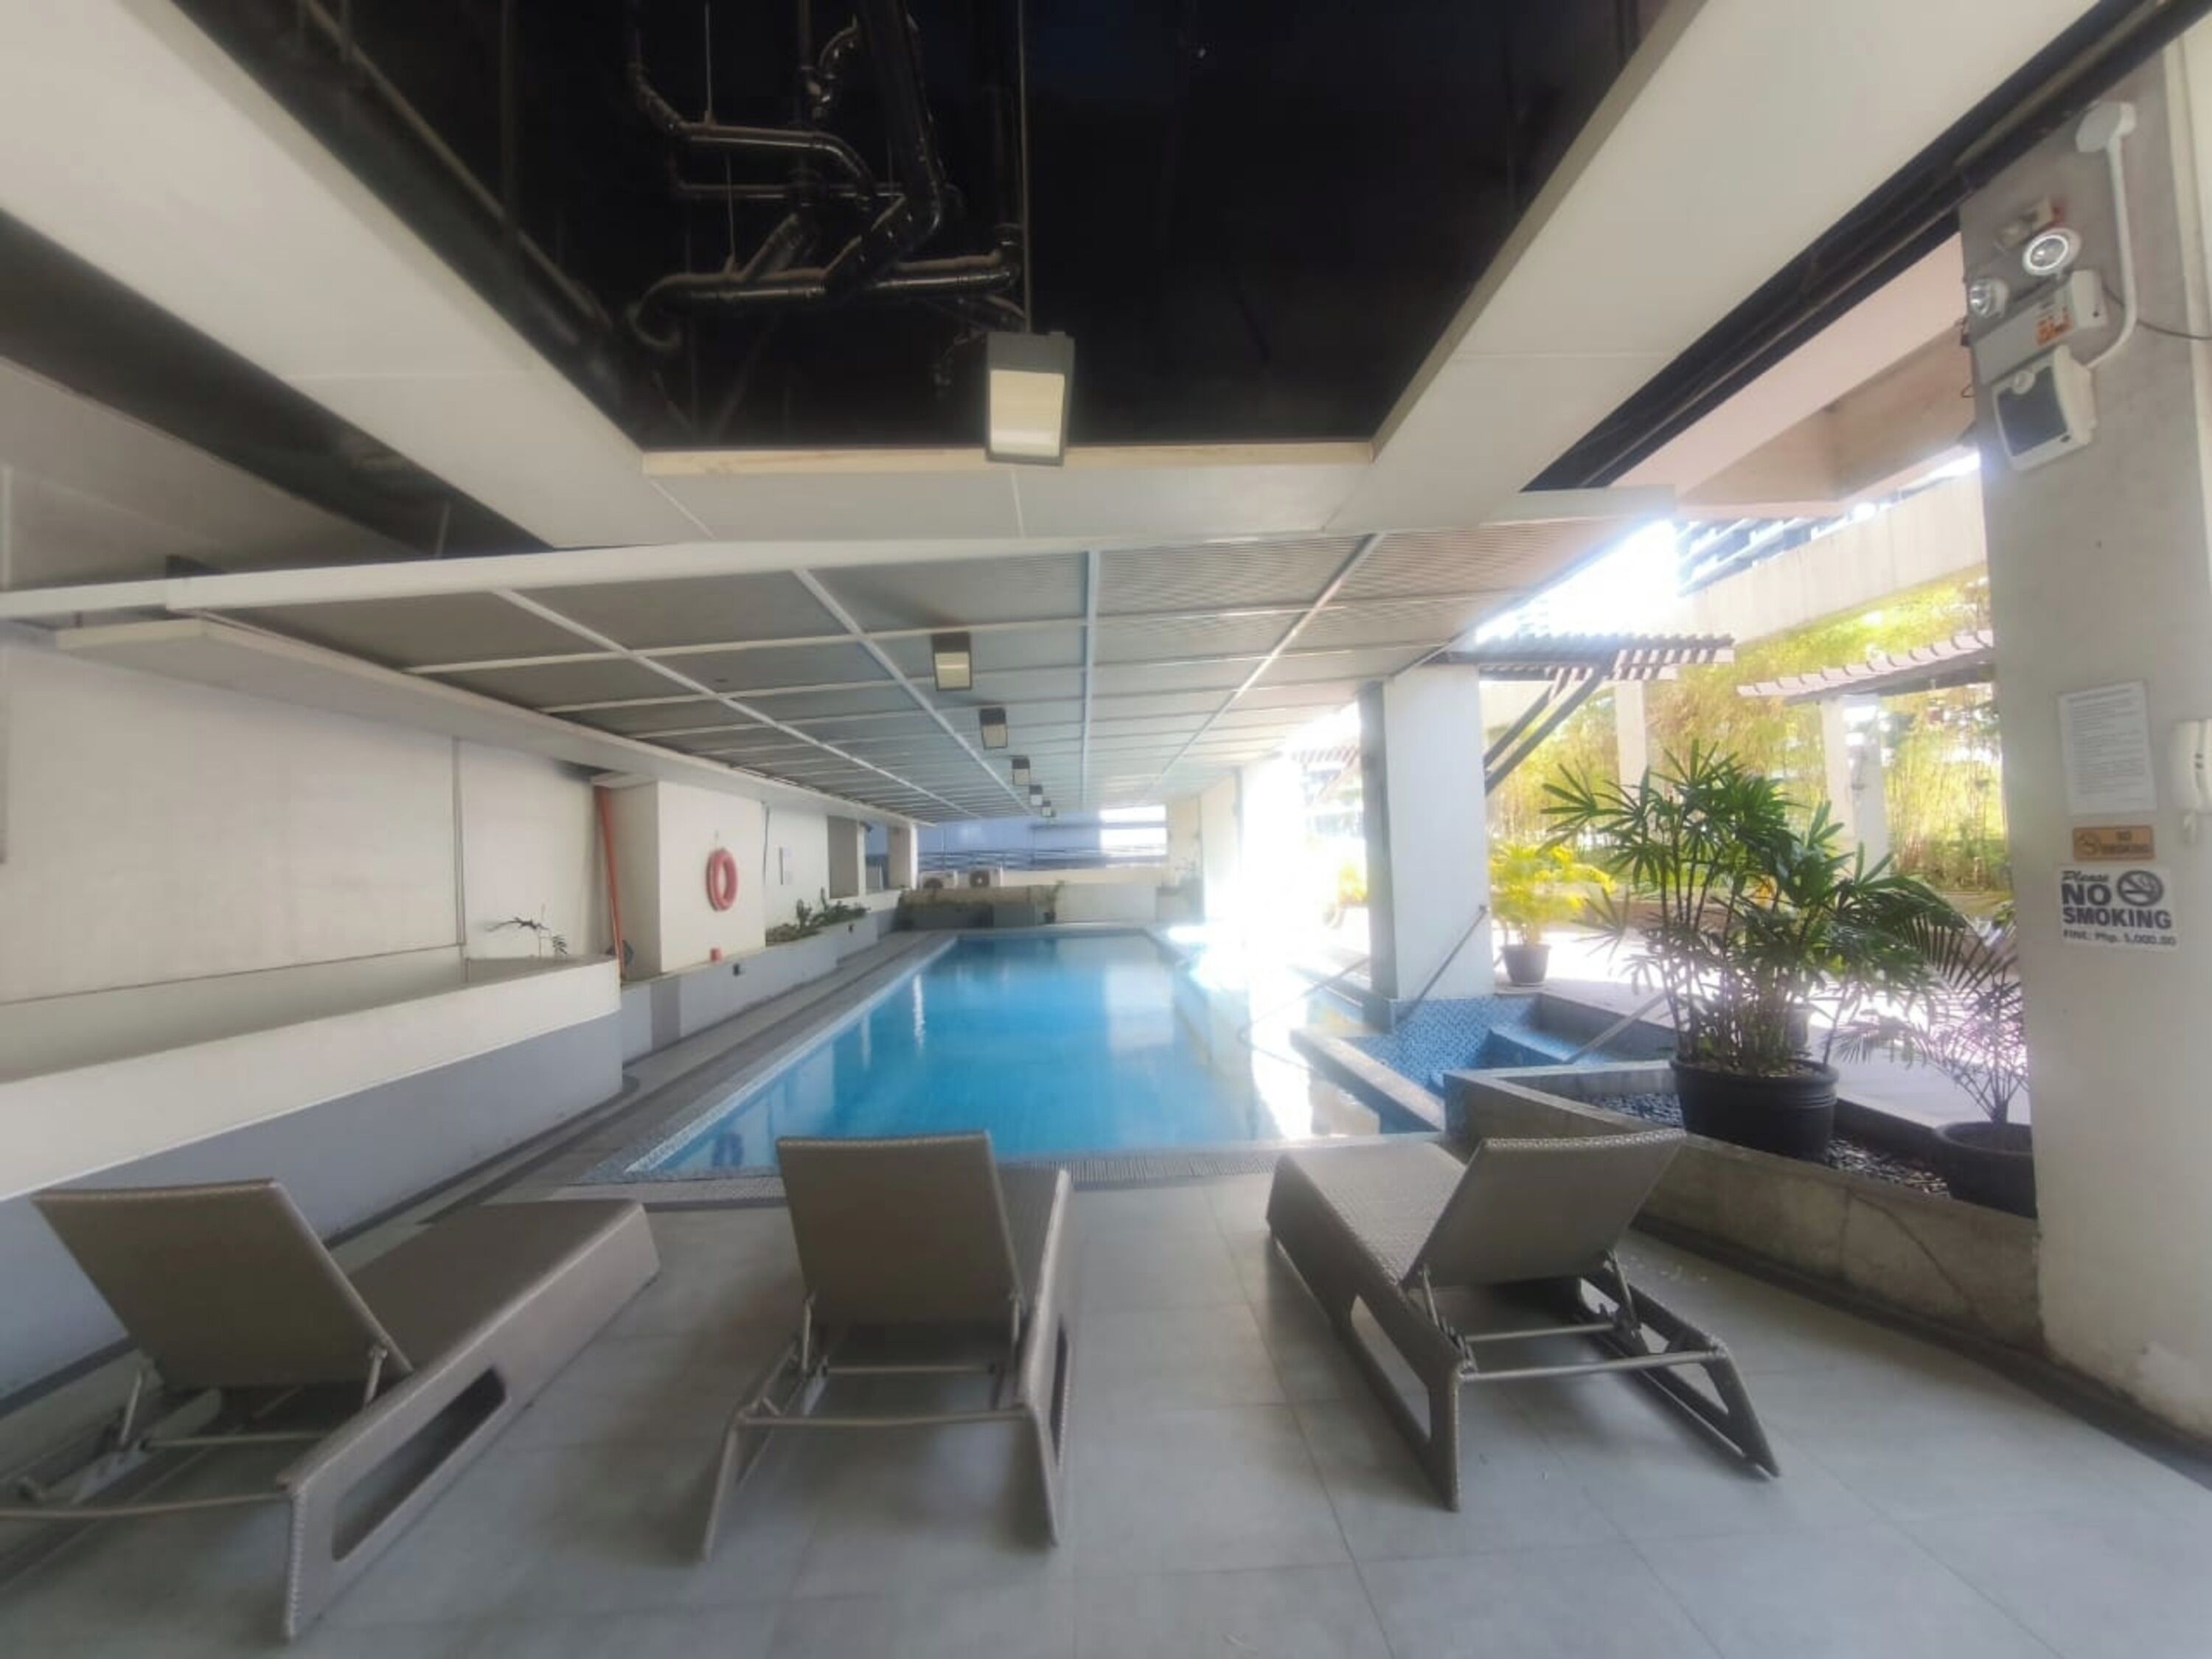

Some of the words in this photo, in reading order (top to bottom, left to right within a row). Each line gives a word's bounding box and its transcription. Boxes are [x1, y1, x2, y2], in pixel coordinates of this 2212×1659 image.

[2062, 870, 2110, 882] Please
[2061, 883, 2112, 906] NO
[2062, 907, 2171, 930] SMOKING
